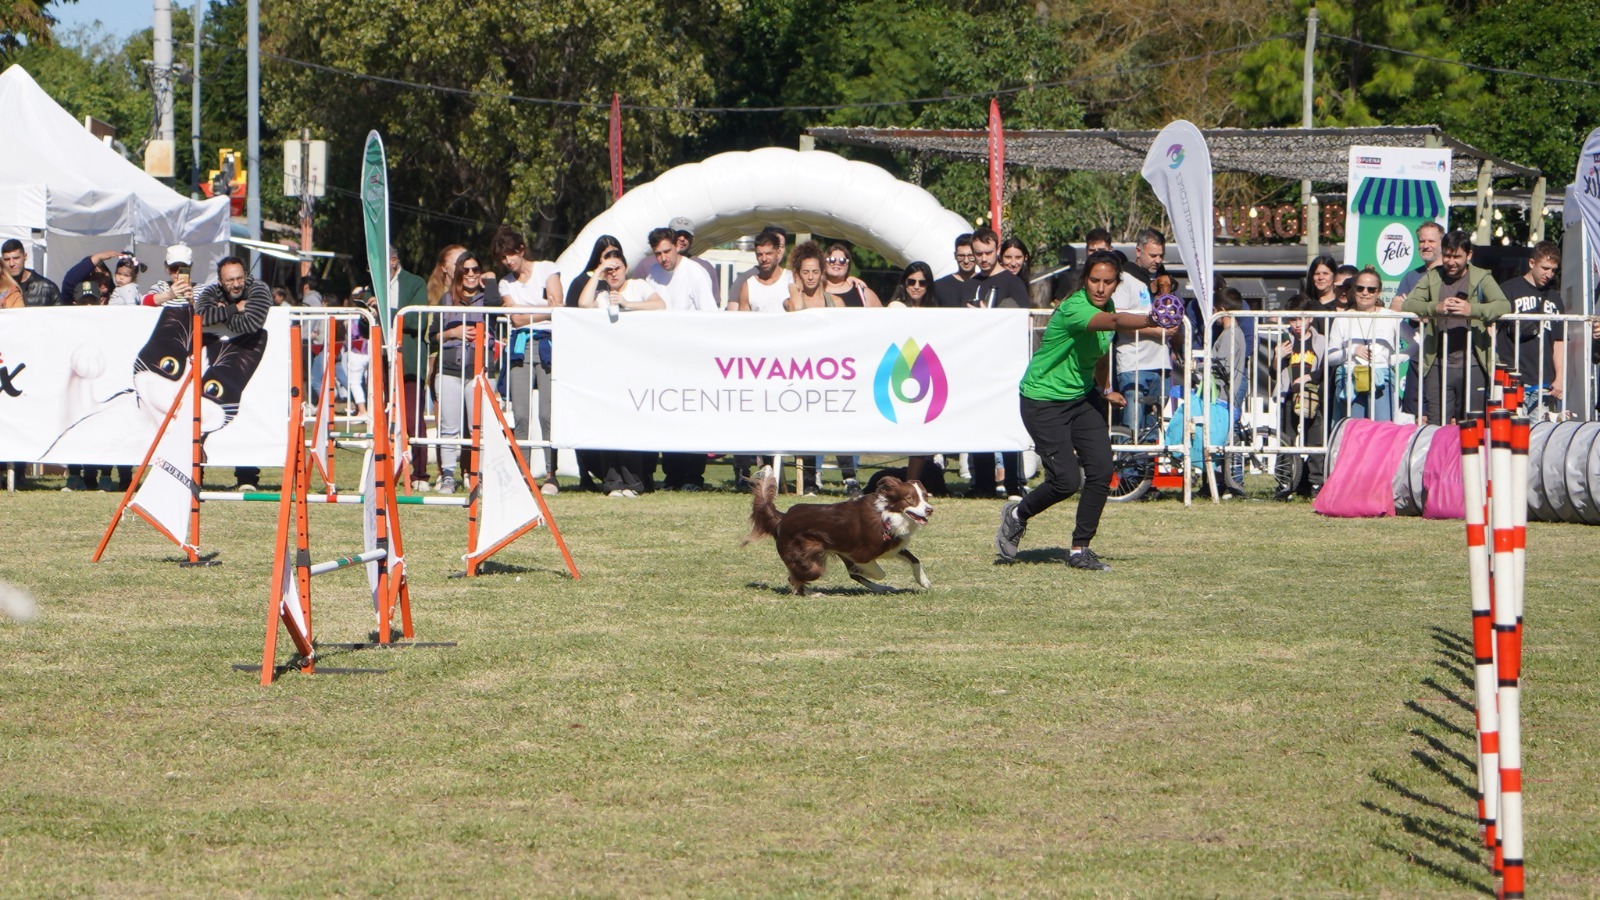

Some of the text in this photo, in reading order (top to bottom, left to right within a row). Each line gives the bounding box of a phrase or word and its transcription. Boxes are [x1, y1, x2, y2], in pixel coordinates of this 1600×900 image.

[1382, 241, 1411, 265] felix
[715, 357, 857, 380] VIVAMOS
[628, 383, 857, 413] VICENTE LÓPEZ
[162, 461, 191, 489] PURINA
